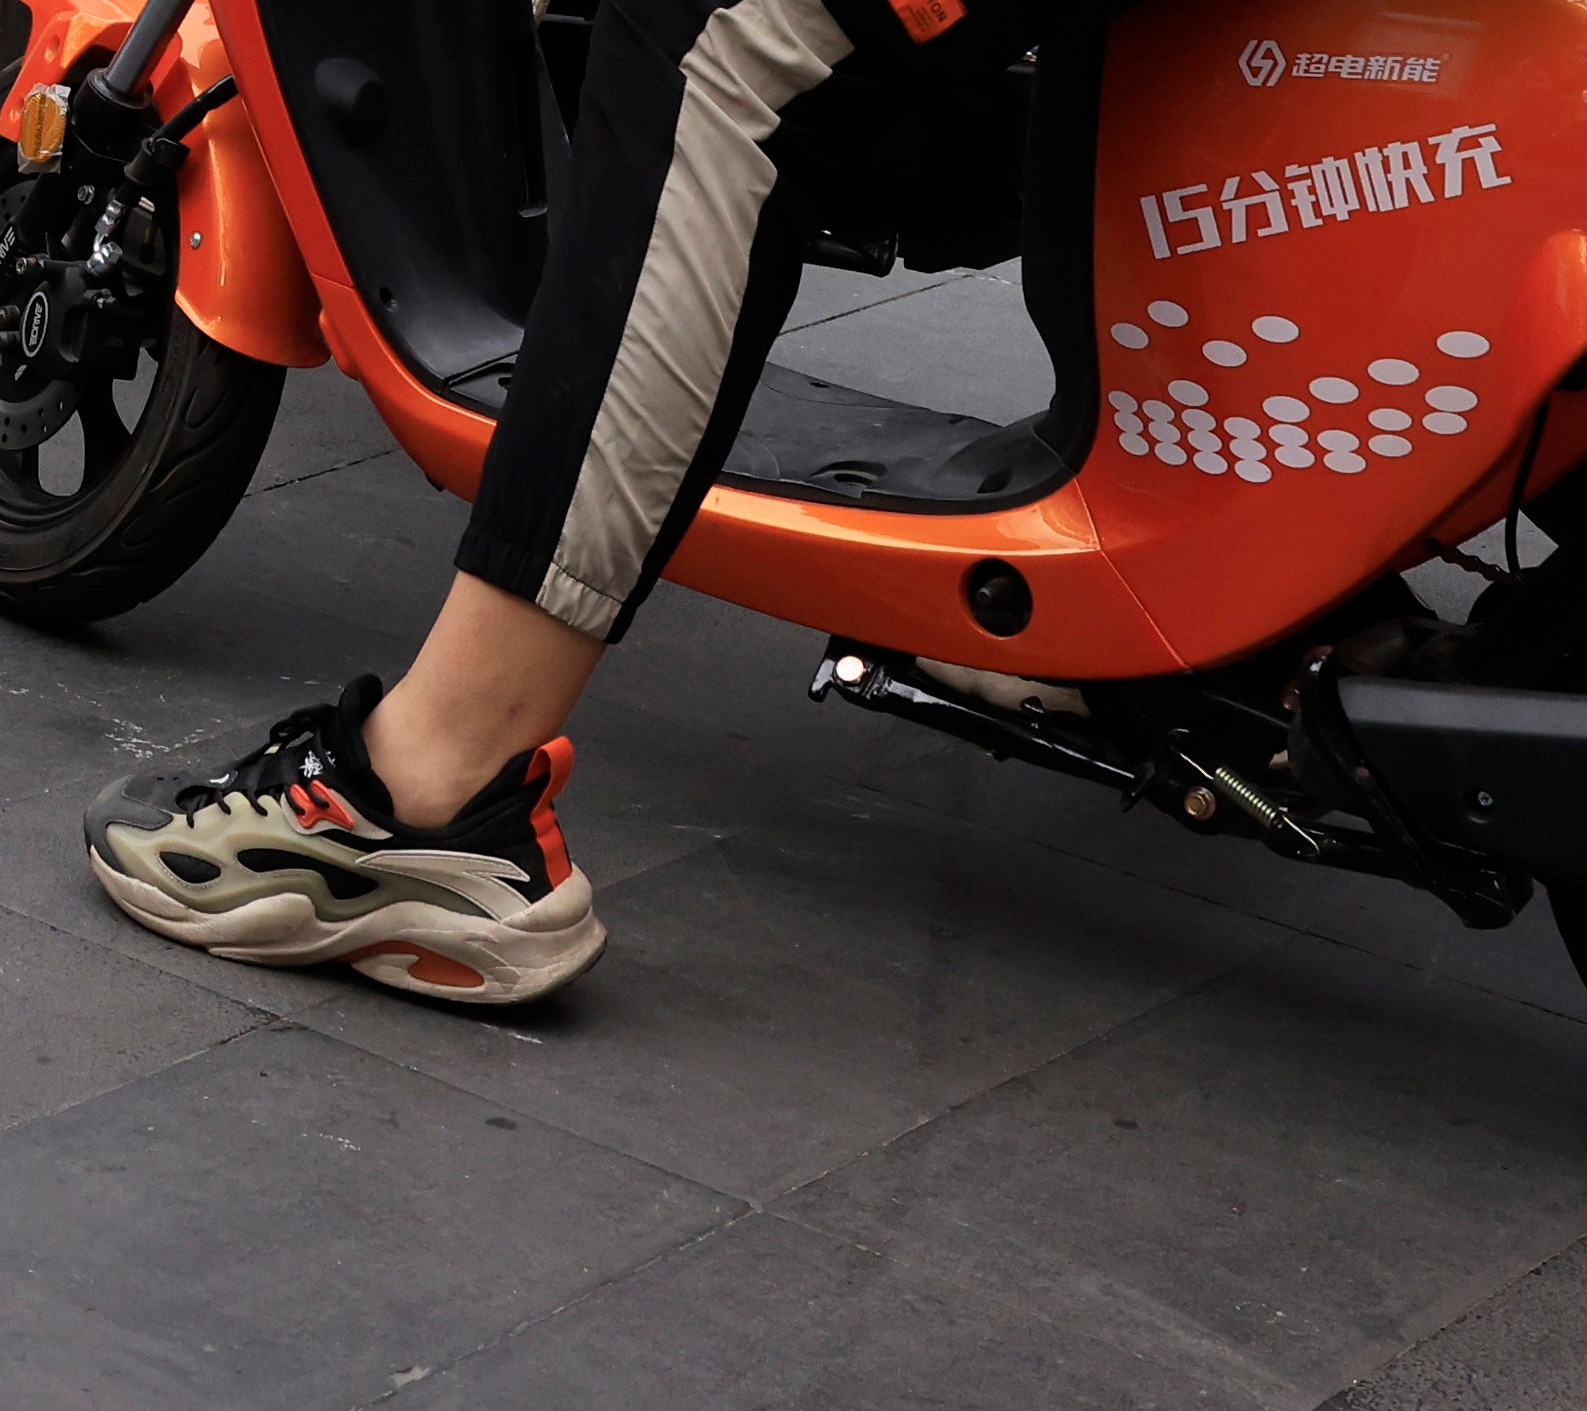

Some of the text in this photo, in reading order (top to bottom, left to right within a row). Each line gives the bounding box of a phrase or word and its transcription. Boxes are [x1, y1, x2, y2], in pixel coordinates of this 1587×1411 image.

[1291, 52, 1443, 83] 超电新能
[1140, 122, 1512, 260] 15分钟快充
